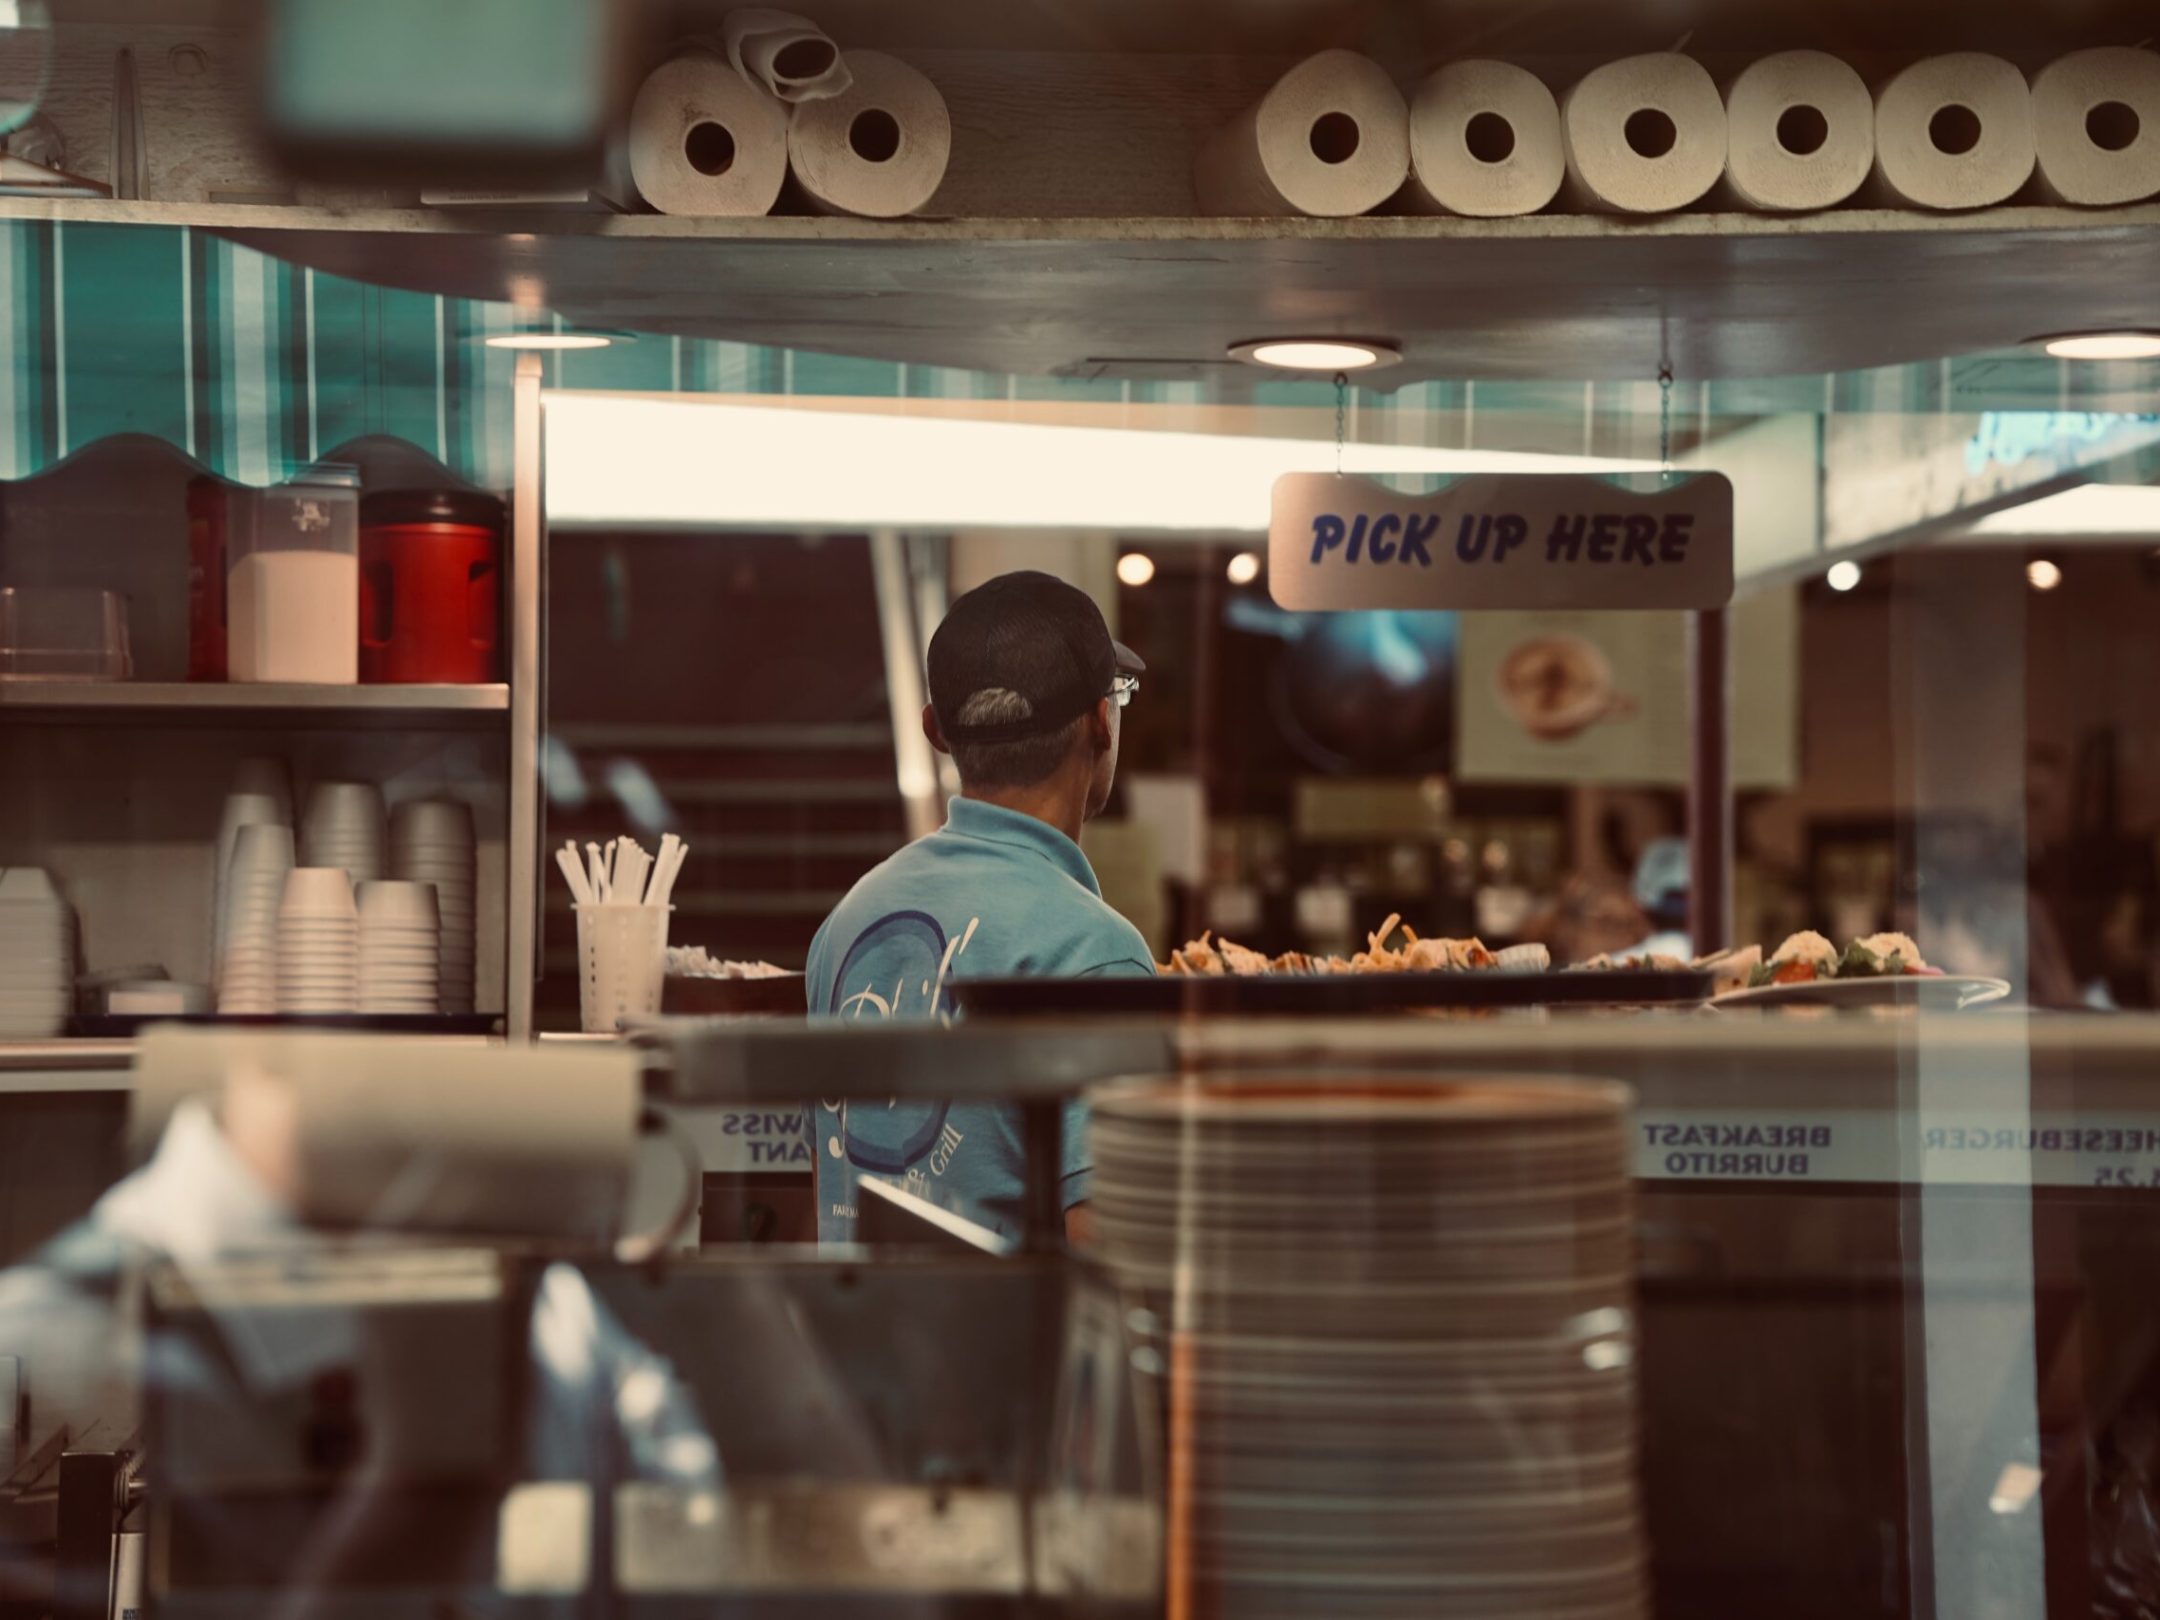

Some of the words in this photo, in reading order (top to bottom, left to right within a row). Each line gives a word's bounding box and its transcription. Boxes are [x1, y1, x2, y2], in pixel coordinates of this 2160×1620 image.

[1309, 512, 1441, 567] PICK
[1455, 512, 1529, 565] UP
[1545, 512, 1695, 567] HERE
[929, 1122, 965, 1177] Grill
